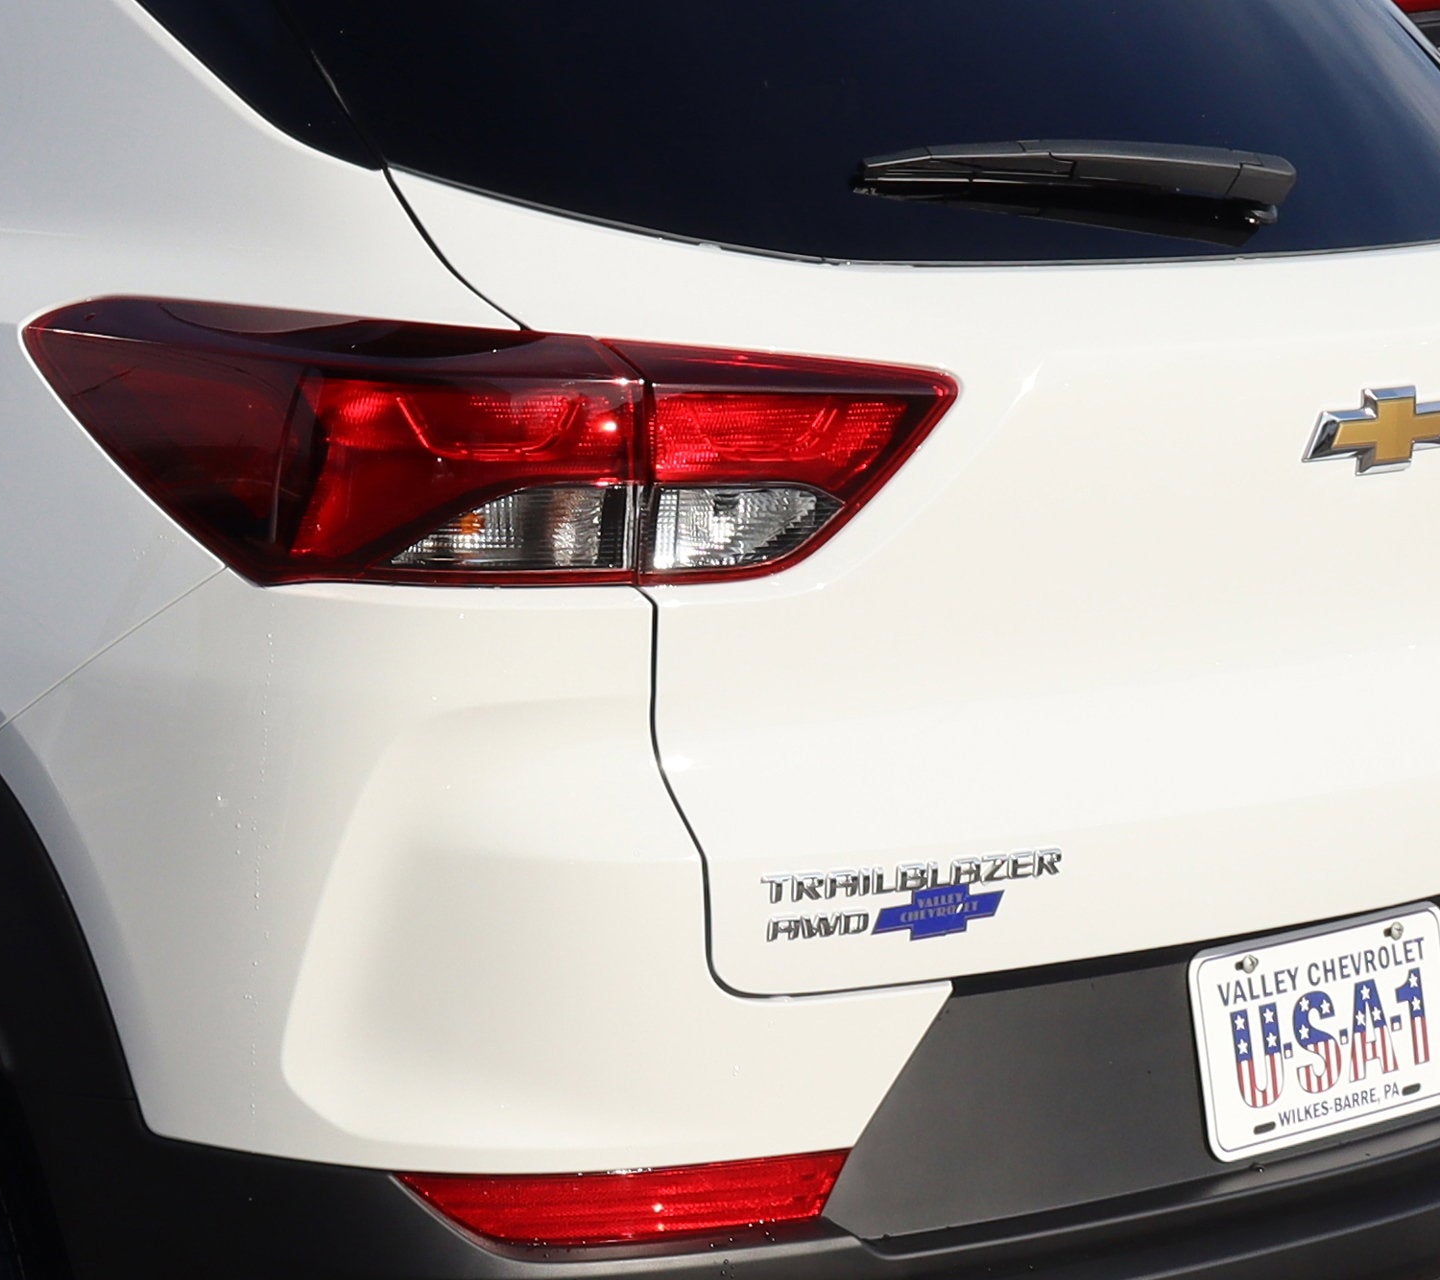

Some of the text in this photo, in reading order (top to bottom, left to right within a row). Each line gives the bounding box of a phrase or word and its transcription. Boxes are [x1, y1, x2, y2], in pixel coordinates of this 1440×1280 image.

[760, 847, 1063, 904] TRAILBLAZER
[900, 901, 979, 923] CHEVROET
[916, 892, 965, 909] VALLEY
[767, 907, 870, 942] AWD
[1217, 937, 1425, 1007] VALLEY CHEVROLET
[1384, 1082, 1400, 1100] PA
